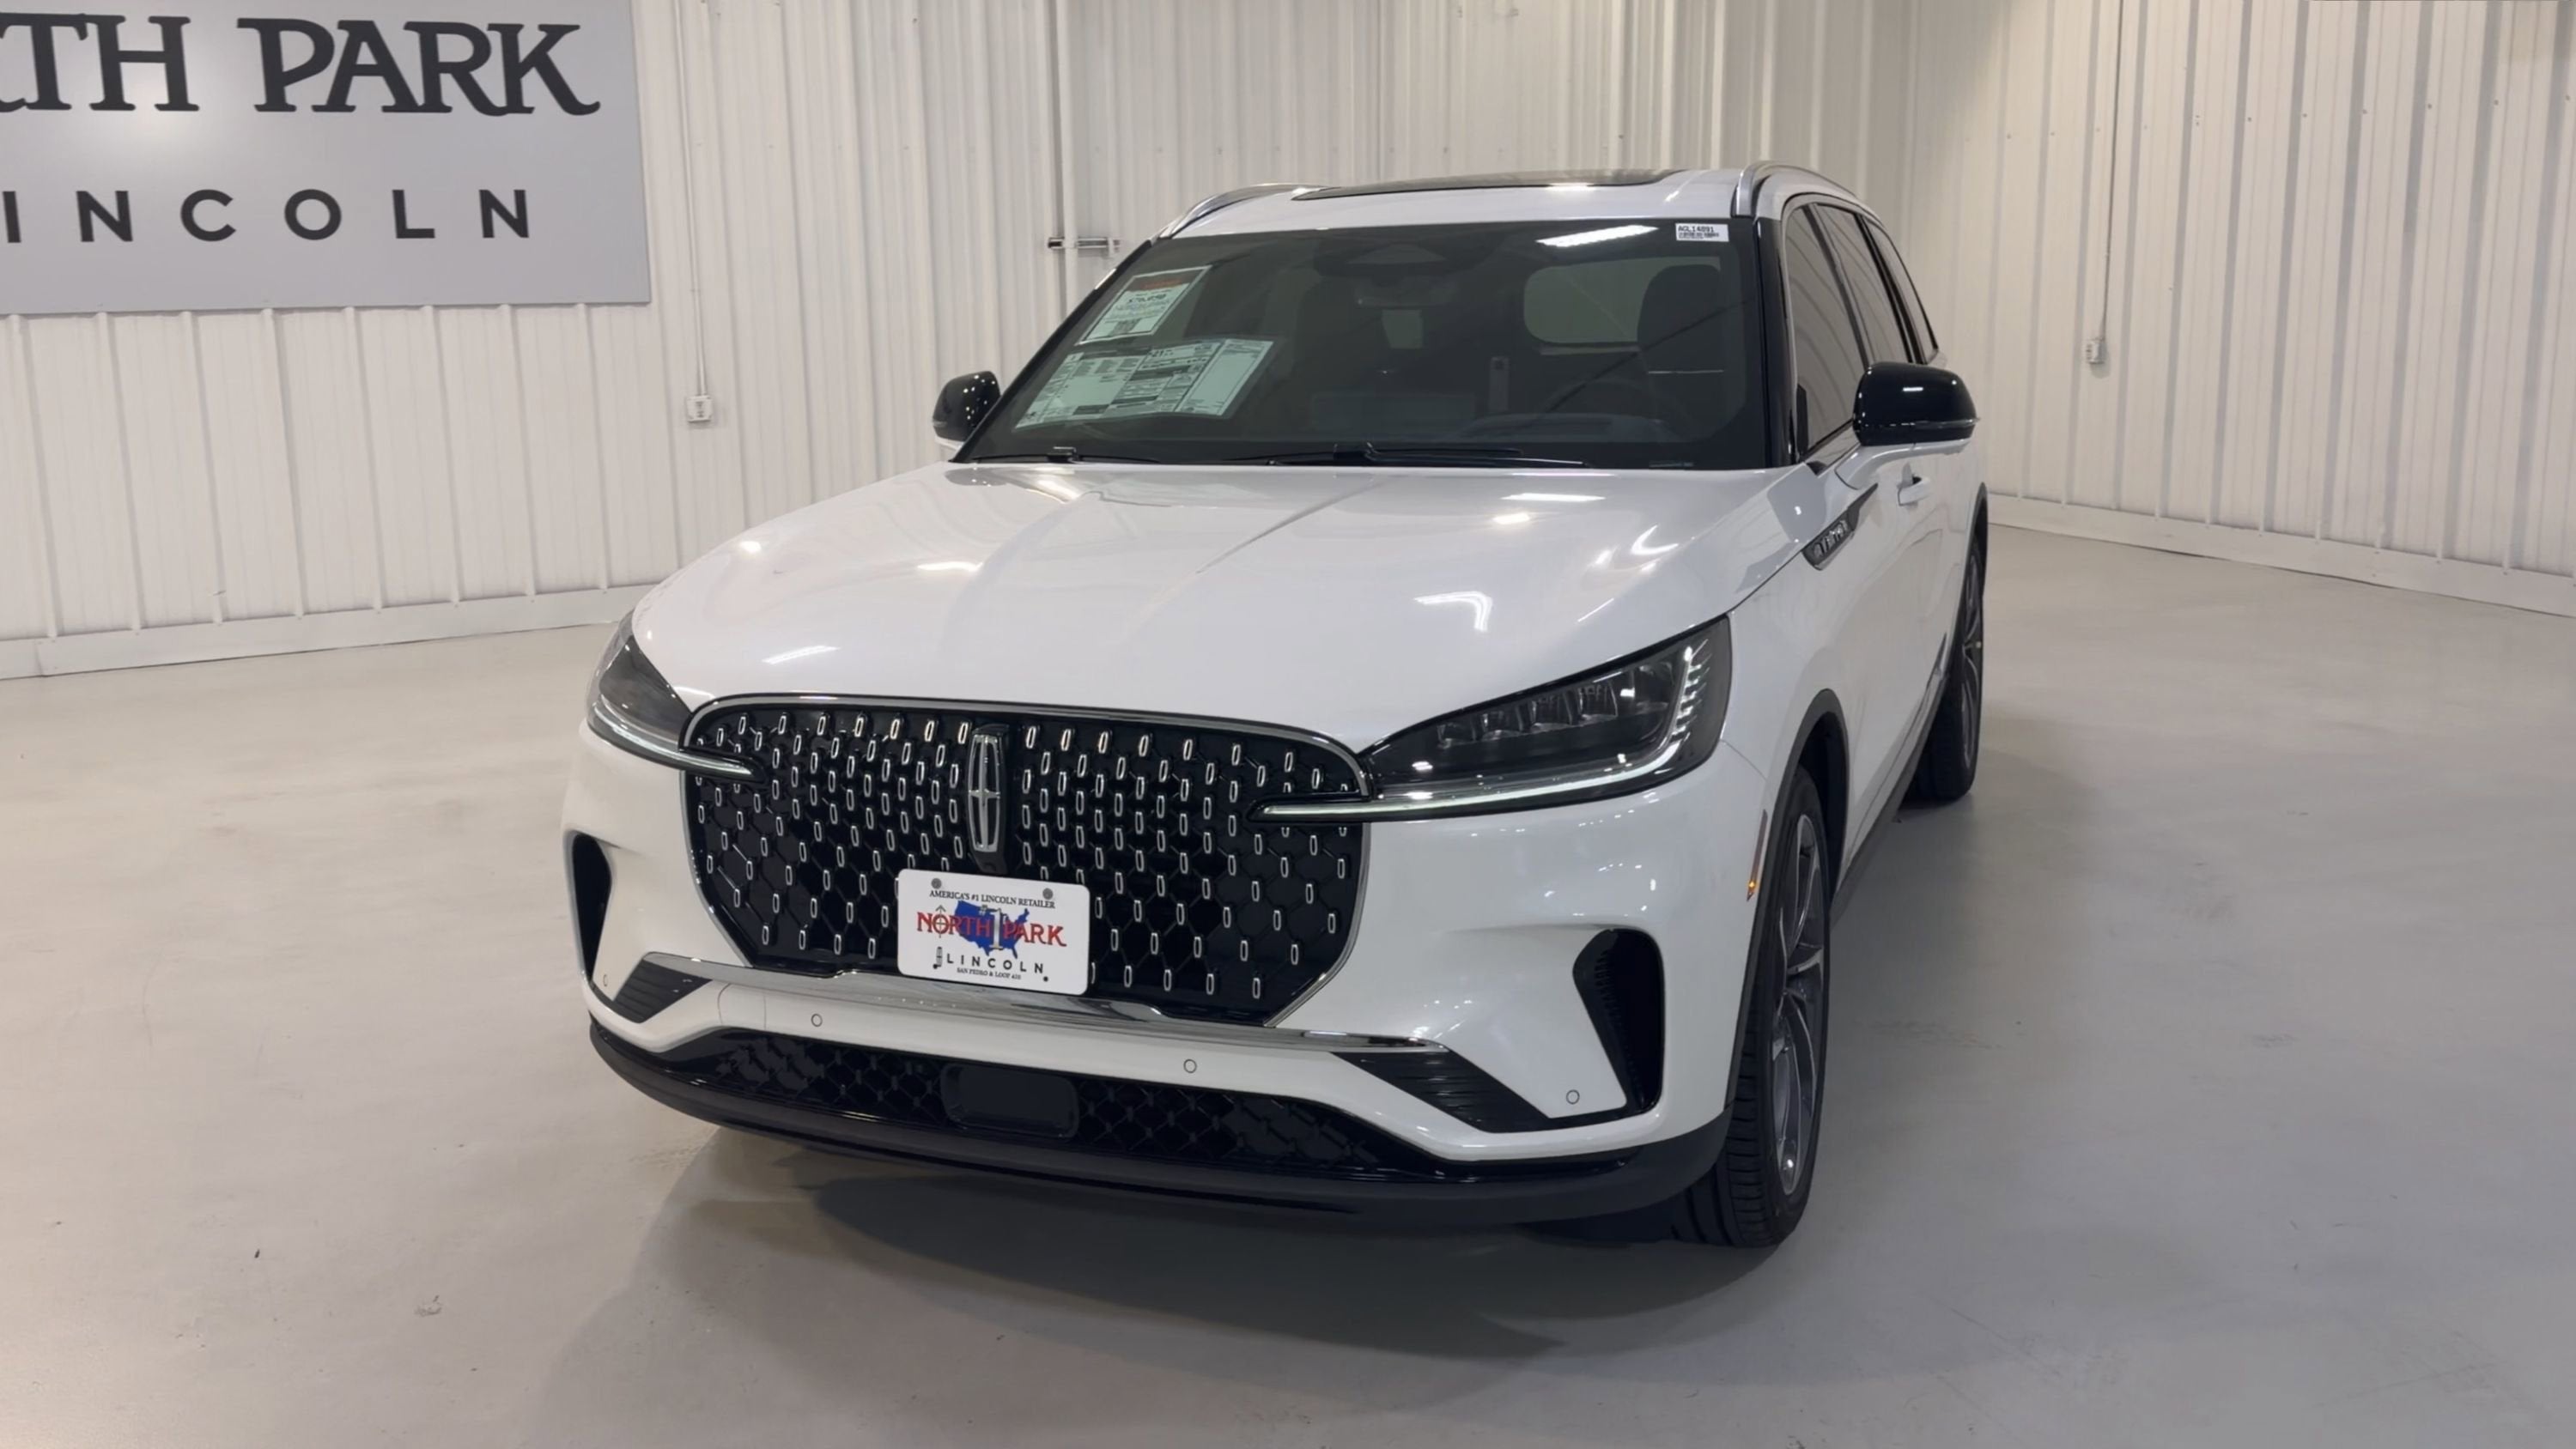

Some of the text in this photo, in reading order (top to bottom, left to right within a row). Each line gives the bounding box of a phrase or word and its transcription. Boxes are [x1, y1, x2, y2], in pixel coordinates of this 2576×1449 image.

[0, 12, 600, 116] TH PARK
[929, 889, 970, 900] AMERICA'S
[981, 894, 1017, 905] LINCOLN
[1018, 898, 1055, 909] RETAILER
[917, 911, 1067, 947] NORTH PARK
[946, 953, 1043, 973] LINCOLN
